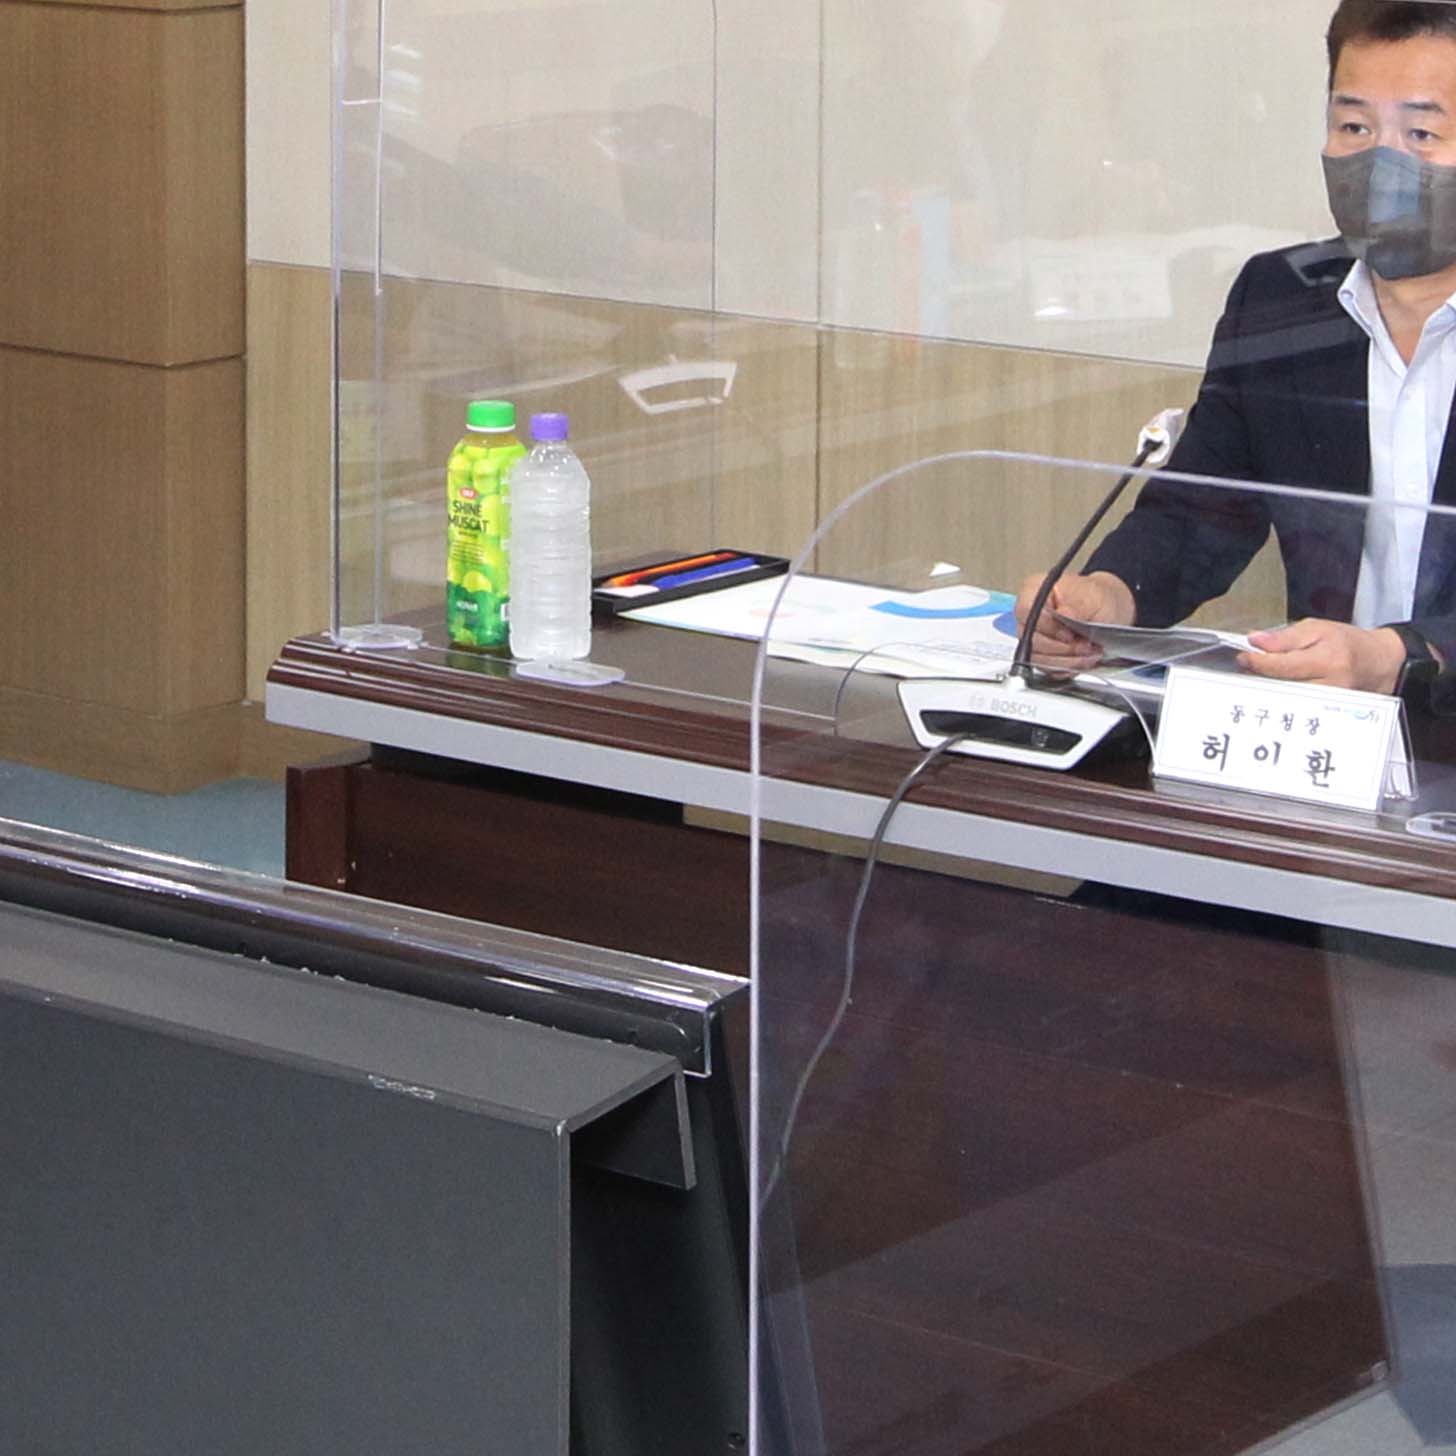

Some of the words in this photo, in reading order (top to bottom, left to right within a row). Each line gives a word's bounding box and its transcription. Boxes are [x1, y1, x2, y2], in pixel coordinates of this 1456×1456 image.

[452, 499, 482, 517] SHINE
[448, 513, 489, 533] MUSCAT
[989, 696, 1040, 718] BOSCH
